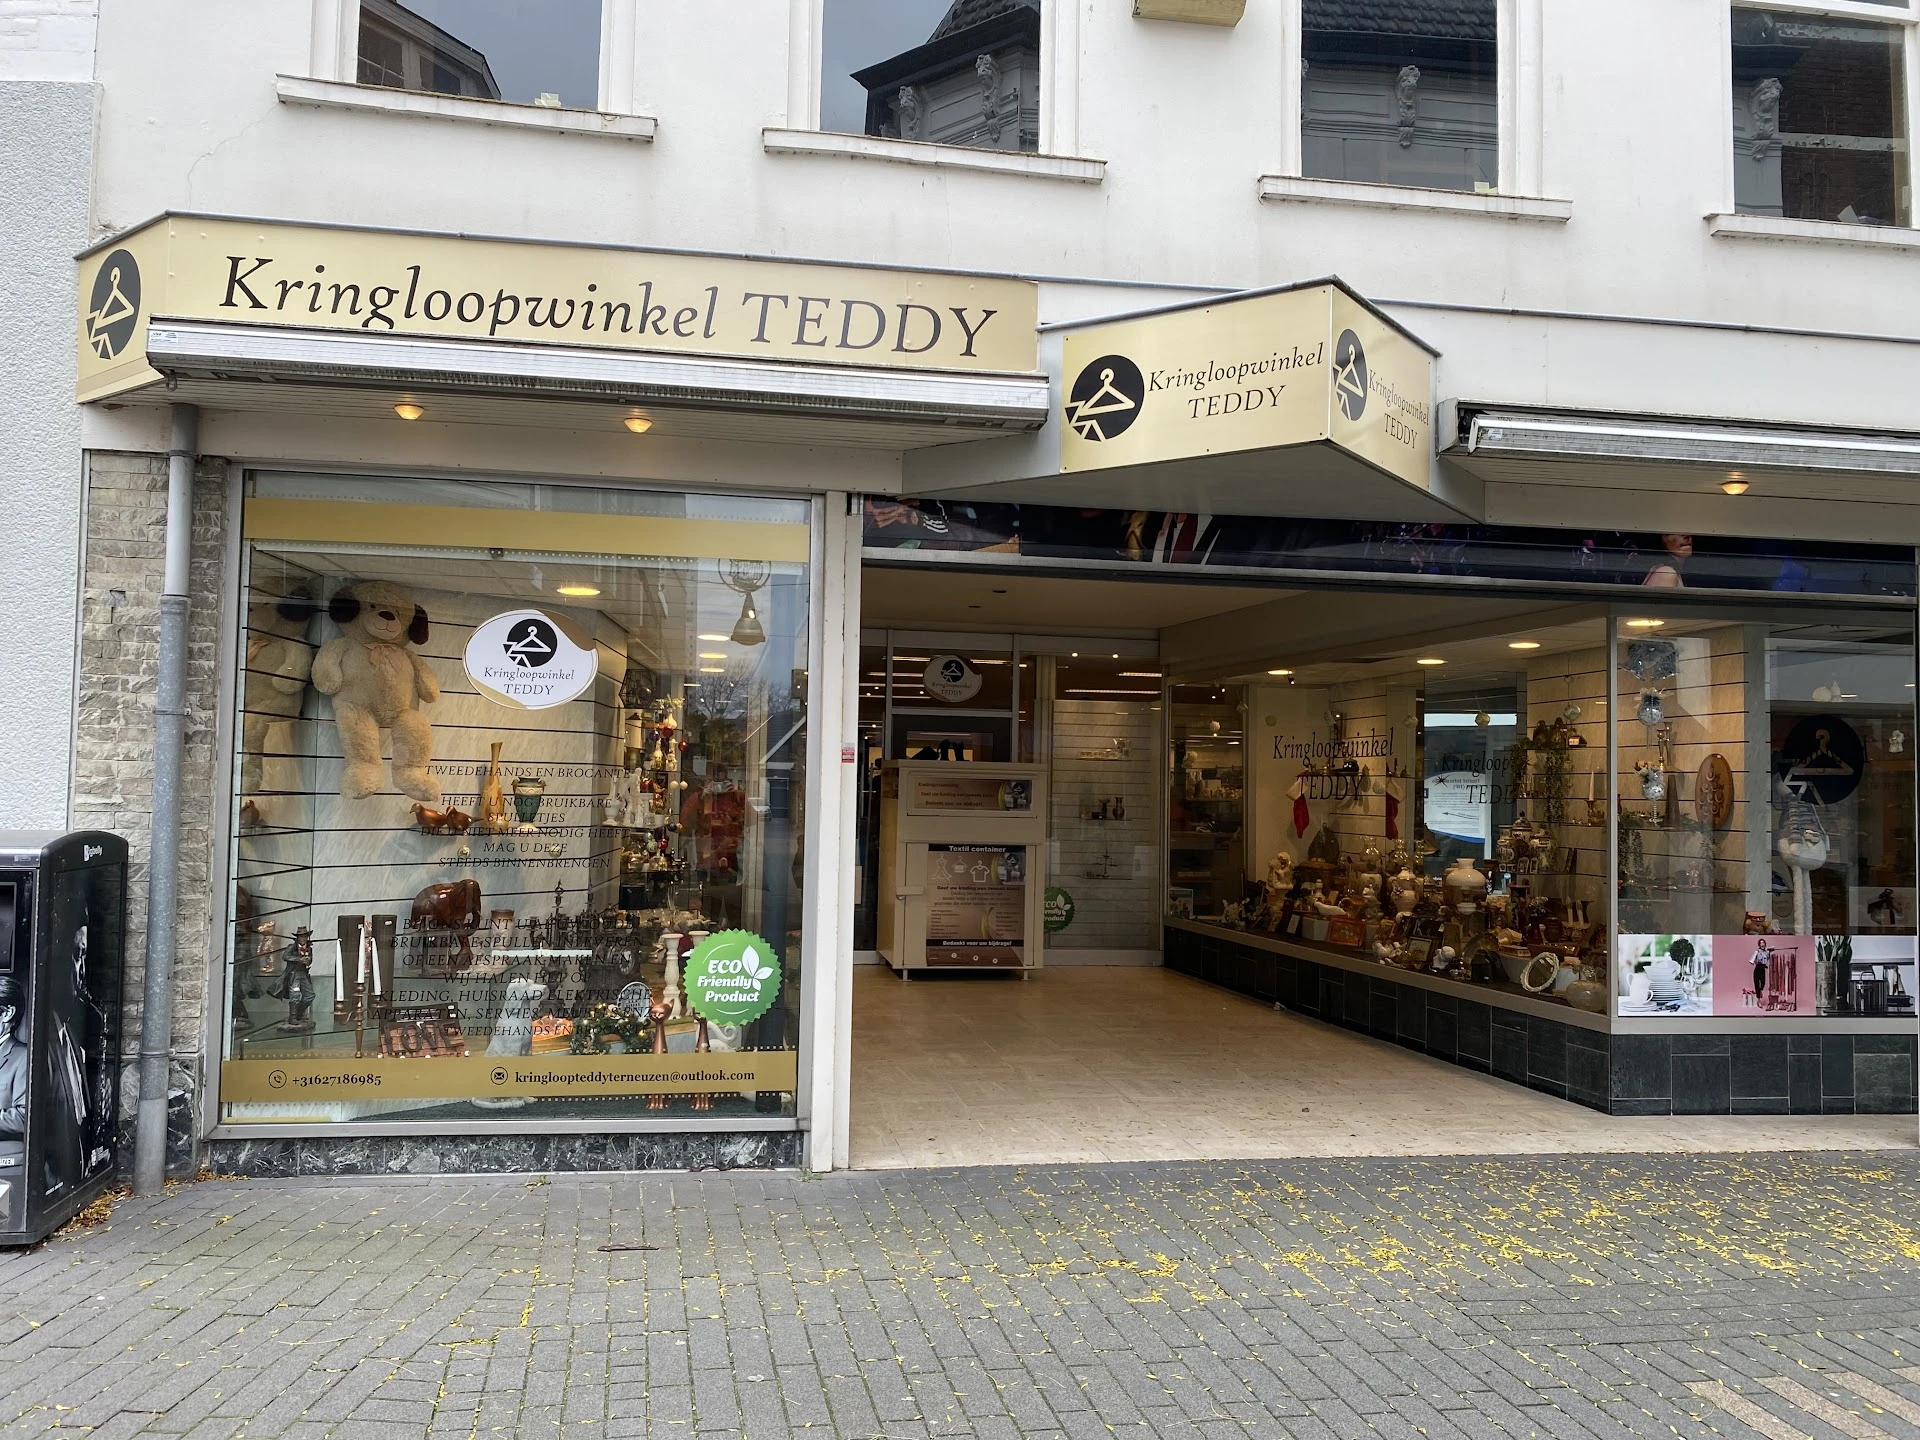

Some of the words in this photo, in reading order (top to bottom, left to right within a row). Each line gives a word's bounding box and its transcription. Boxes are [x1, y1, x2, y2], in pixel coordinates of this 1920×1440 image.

[218, 255, 718, 339] Kringloopwinkel
[742, 292, 997, 357] TEDDY
[1148, 341, 1324, 393] Kringloopwinkel
[1187, 384, 1287, 419] TEDDY
[1368, 368, 1430, 426] Kringloopwinkel
[1384, 412, 1418, 449] TEDDY
[484, 666, 576, 682] Kringloopwinkel
[503, 683, 556, 696] TEDDY
[1272, 726, 1395, 768] Kringloopwinkel
[425, 763, 532, 778] TWEEDEHANDS
[535, 766, 555, 778] EN
[558, 766, 631, 780] BROCANTE
[1295, 774, 1365, 801] TEDDY
[441, 796, 486, 807] HEEFT
[488, 796, 499, 807] U
[503, 796, 536, 808] NOG
[538, 797, 612, 809] BRUIKBARE
[487, 811, 567, 824] SPULLETJES
[537, 827, 585, 838] NODIG
[483, 842, 516, 853] MAG
[520, 842, 530, 853] U
[532, 842, 568, 853] DEZE
[438, 857, 490, 869] STEEDS
[493, 857, 612, 869] BINNENBRENGEN
[463, 954, 545, 966] AFSPRAAK
[707, 959, 744, 975] ECO
[444, 972, 470, 986] WIJ
[474, 972, 531, 985] HALEN
[696, 974, 753, 991] Friendly
[704, 990, 762, 1004] Product
[292, 1073, 382, 1088] +31627186985
[515, 1070, 756, 1086] kringloopteddyterneuzen@outlook.com
